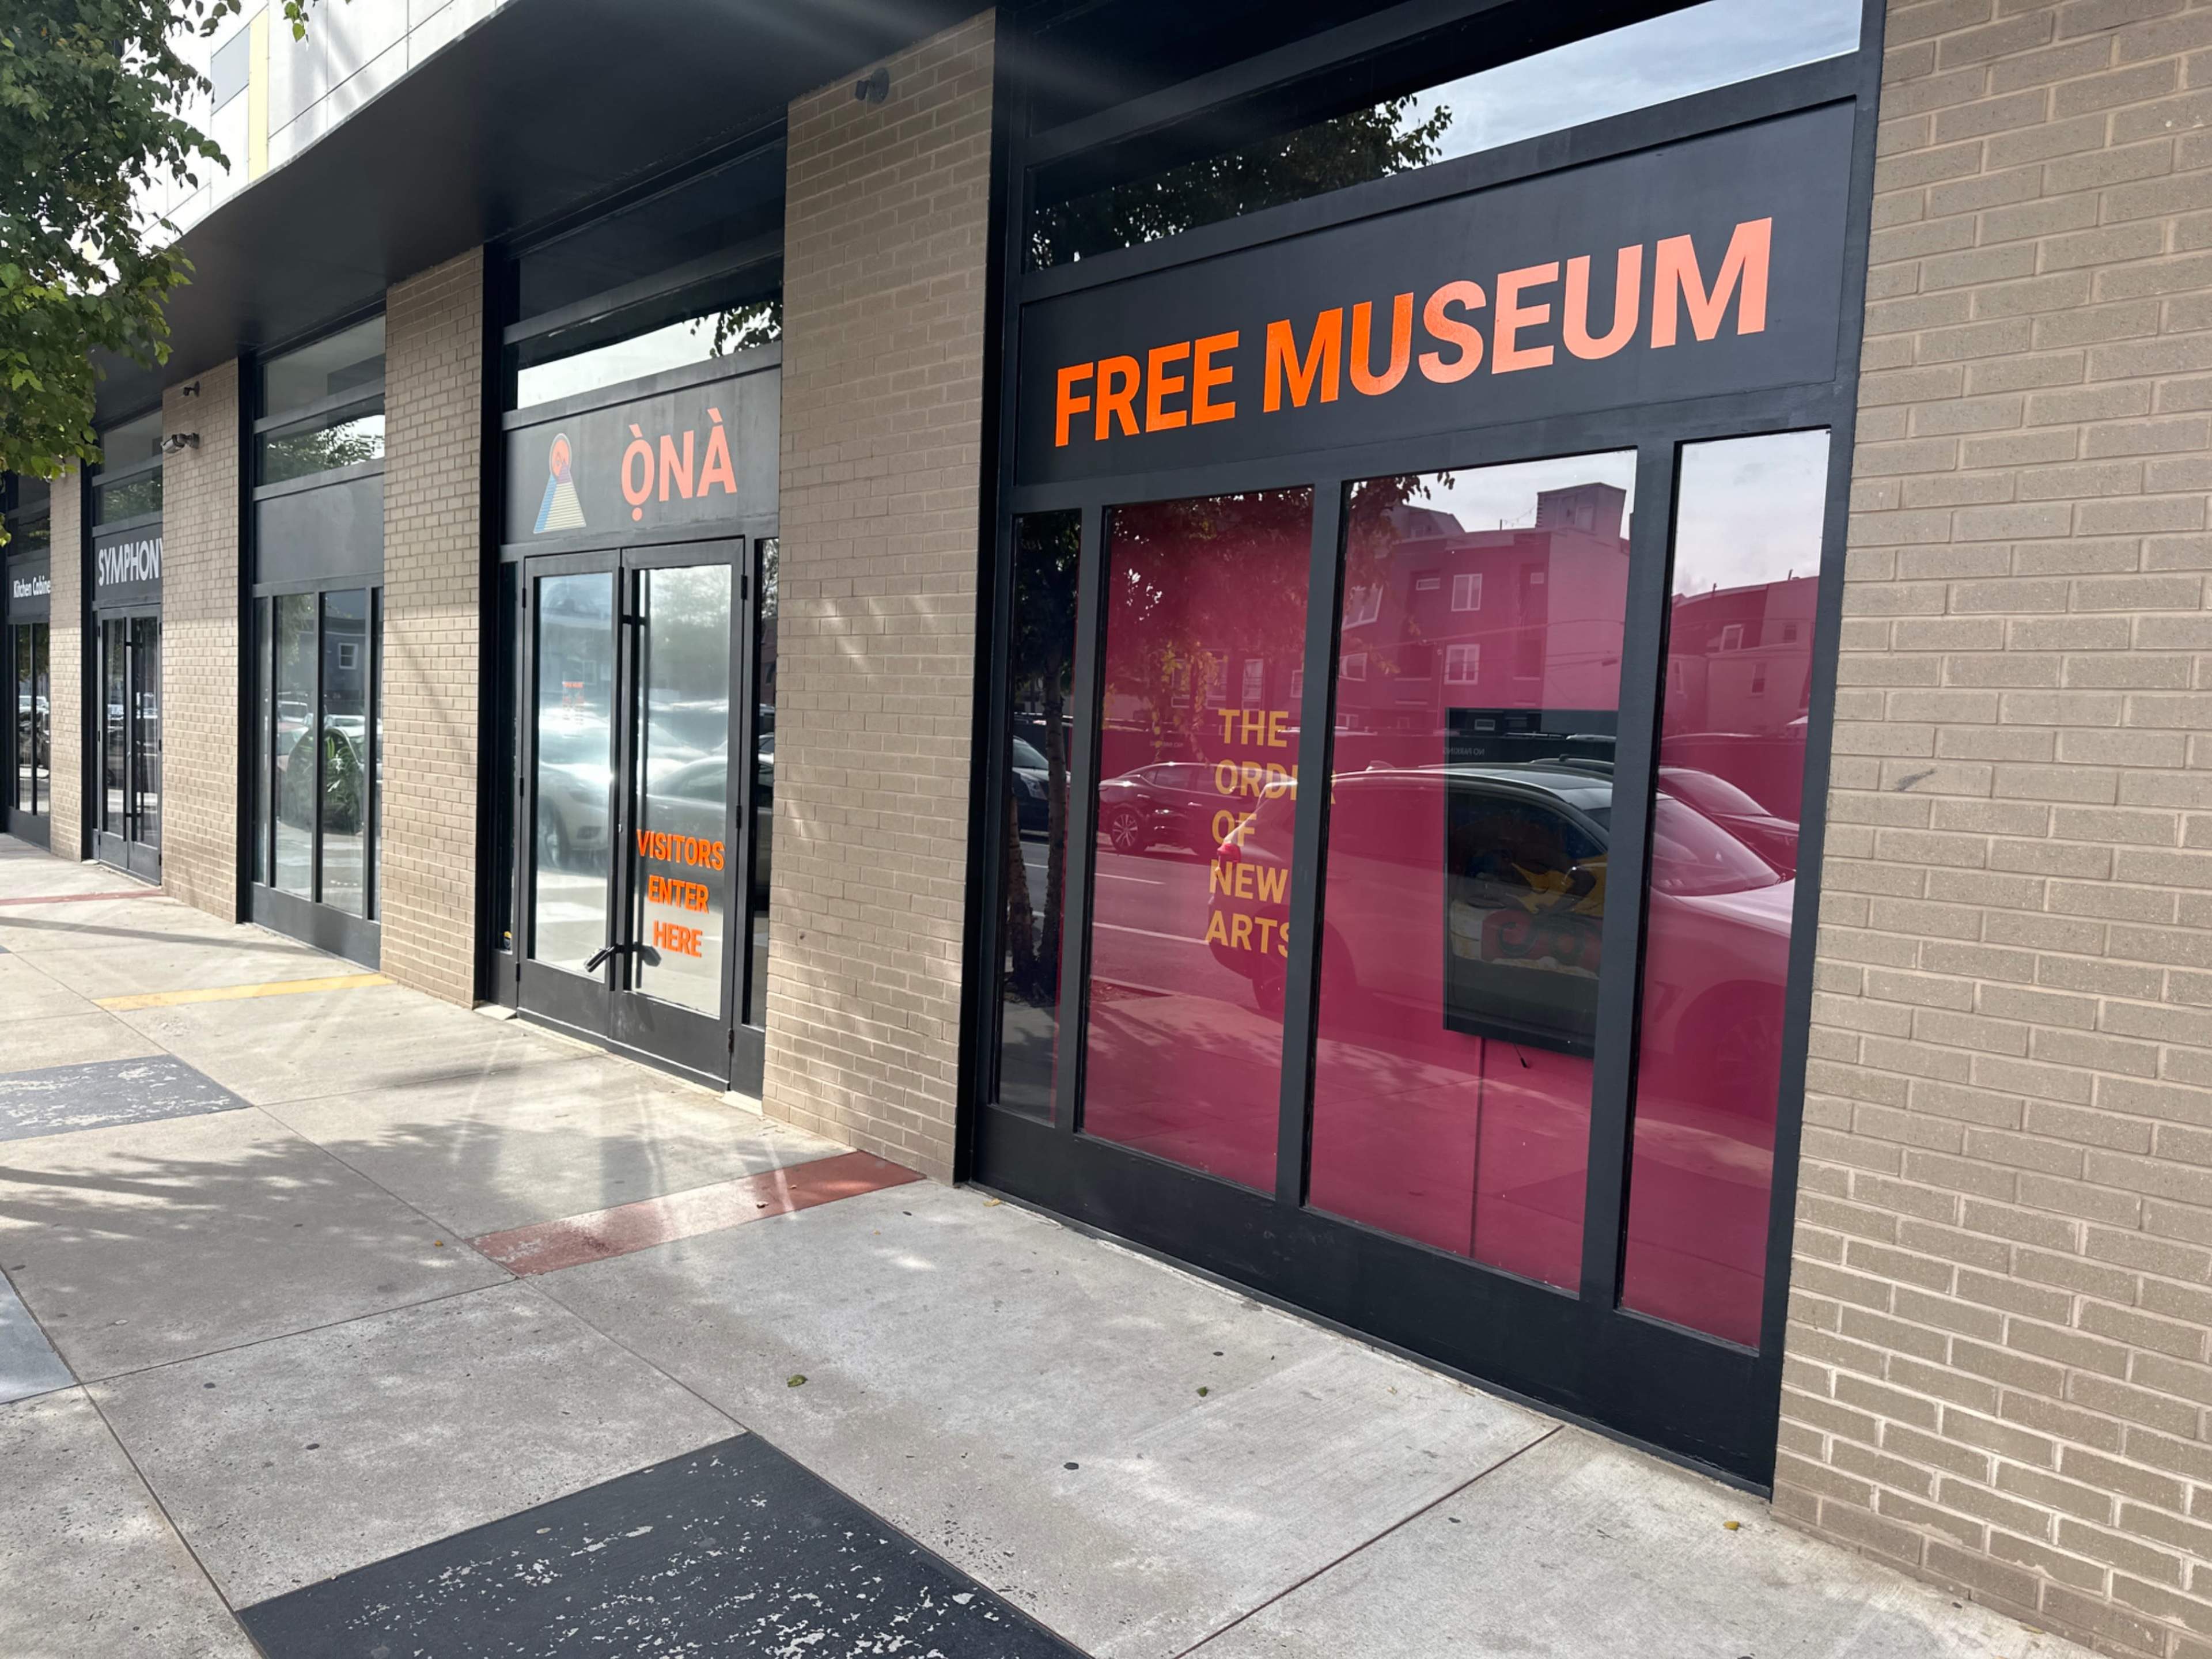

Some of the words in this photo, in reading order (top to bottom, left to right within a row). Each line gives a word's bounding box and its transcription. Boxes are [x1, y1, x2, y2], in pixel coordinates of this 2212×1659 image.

[1055, 330, 1240, 447] FREE
[1263, 218, 1772, 413] MUSEUM
[13, 578, 32, 598] Kitchen
[1218, 709, 1289, 747] THE
[1212, 810, 1257, 847] OF
[637, 829, 725, 870] VISITORS
[647, 875, 709, 913] ENTER
[1210, 859, 1288, 903] NEW
[653, 921, 702, 957] HERE
